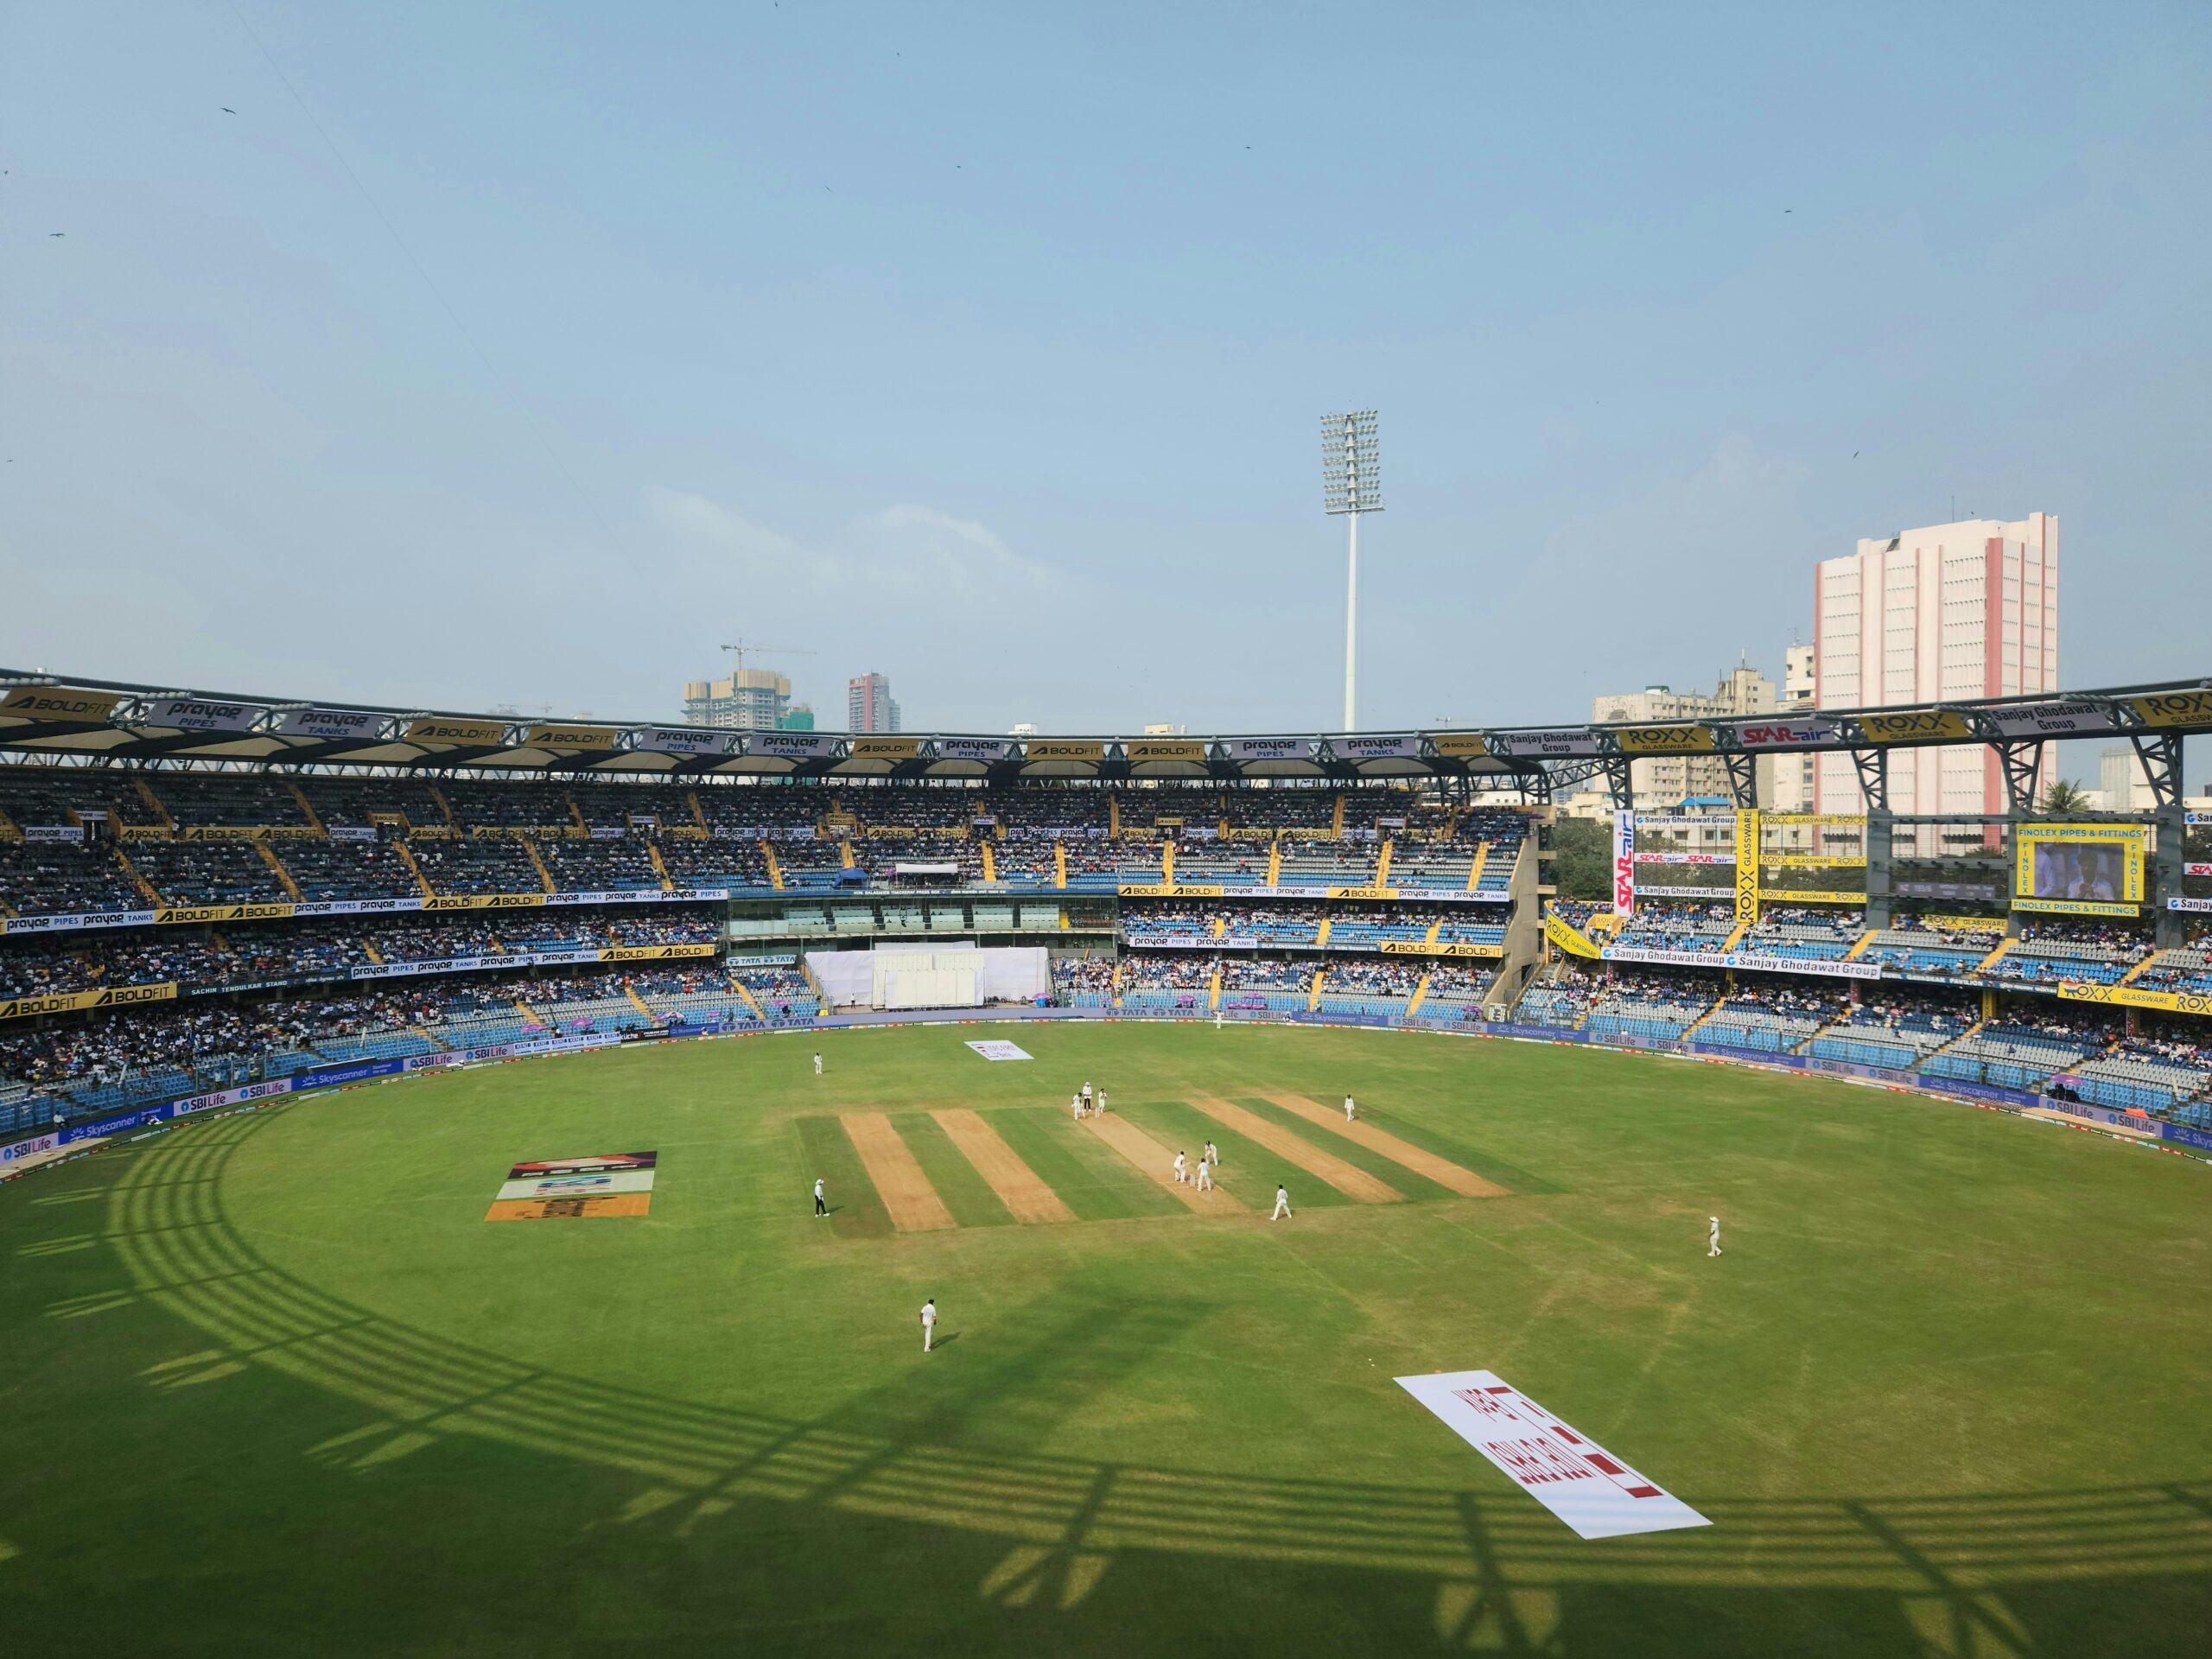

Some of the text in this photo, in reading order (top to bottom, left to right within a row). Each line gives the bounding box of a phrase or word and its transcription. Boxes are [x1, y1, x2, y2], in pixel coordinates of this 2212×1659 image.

[35, 698, 111, 715] BOLDFIT
[166, 702, 244, 719] prayag
[1993, 701, 2099, 725] Sanjay Ghodawat
[178, 717, 218, 728] PIPES
[299, 713, 368, 728] prayag
[1871, 710, 1951, 734] ROXX
[2037, 718, 2076, 732] Group
[308, 726, 350, 735] TANKS
[437, 727, 499, 740] BOLDFIT
[1629, 729, 1699, 744] ROXX
[1889, 729, 1946, 741] GLASSWARE
[554, 732, 612, 744] BOLDFIT
[656, 732, 714, 745] prayag
[764, 737, 819, 747] prayag
[946, 738, 1000, 750] prayag
[1510, 732, 1592, 746] Sanjay Ghodawat
[667, 742, 696, 752] PIPES
[1243, 741, 1296, 752] prayag
[1347, 739, 1402, 750] prayag
[1542, 743, 1571, 753] Group
[1051, 747, 1100, 755] BOLDFIT
[1151, 747, 1201, 755] BOLDFIT
[1645, 816, 1671, 825] Sanjay
[1763, 816, 1789, 824] ROXX
[1837, 816, 1866, 824] ROXX
[207, 830, 253, 838] BOLDFIT
[274, 829, 316, 838] BOLDFIT
[2098, 830, 2142, 838] FITTINGS
[1740, 810, 1755, 920] ROXX GLASSWARE
[1133, 887, 1169, 895] BOLDFIT
[1224, 887, 1253, 897] prayag
[1276, 887, 1306, 898] prayag
[1398, 890, 1429, 899] prayag
[1643, 887, 1735, 897] Sanjay Ghodawat Group
[1761, 890, 1787, 899] ROXX
[1835, 892, 1865, 901] ROXX
[7, 918, 50, 932] prayag
[54, 917, 79, 926] PIPES
[84, 913, 124, 927] prayag
[128, 913, 153, 922] TANKS
[176, 909, 226, 922] BOLDFIT
[246, 905, 293, 917] BOLDFIT
[295, 902, 331, 914] prayag
[360, 899, 396, 912] prayag
[441, 898, 484, 908] BOLDFIT
[502, 895, 543, 906] BOLDFIT
[546, 893, 579, 905] prayag
[661, 890, 696, 901] prayag
[2014, 901, 2051, 910] FINOLEX
[2054, 903, 2081, 912] PIPES
[2092, 906, 2136, 915] FITTINGS
[2180, 899, 2212, 912] Sanjay
[1927, 914, 2005, 927] ROXX GLASSWARE
[1135, 937, 1168, 947] prayag
[1196, 938, 1230, 948] prayag
[1547, 919, 1597, 957] ROXX GLASSWARE
[1398, 944, 1502, 957] BOLDFIT BOLDFIT
[353, 965, 389, 977] prayag
[393, 963, 414, 972] PIPES
[418, 961, 453, 974] prayag
[480, 957, 515, 969] prayag
[543, 952, 575, 964] prayag
[616, 949, 657, 960] BOLDFIT
[674, 946, 715, 957] BOLDFIT
[1614, 950, 1725, 965] Sanjay Ghodawat Group
[1739, 957, 1778, 970] Sanjay
[1781, 960, 1840, 973] Ghodawat
[1843, 964, 1878, 976] Group
[221, 982, 262, 993] TENDULKAR
[1949, 977, 1984, 987] PAVILION
[21, 986, 170, 1014] BOLDFIT BOLDFIT
[2121, 993, 2170, 1004] GLASSWARE
[738, 1020, 766, 1030] TATA
[787, 1017, 815, 1027] TATA
[1314, 1014, 1356, 1025] Skyscanner
[1511, 1026, 1555, 1039] Skyscanner
[1721, 1048, 1770, 1062] Skyscanner
[319, 1068, 367, 1084] Skyscanner
[1947, 1081, 1999, 1099] Skyscanner
[86, 1116, 137, 1137] Skyscanner
